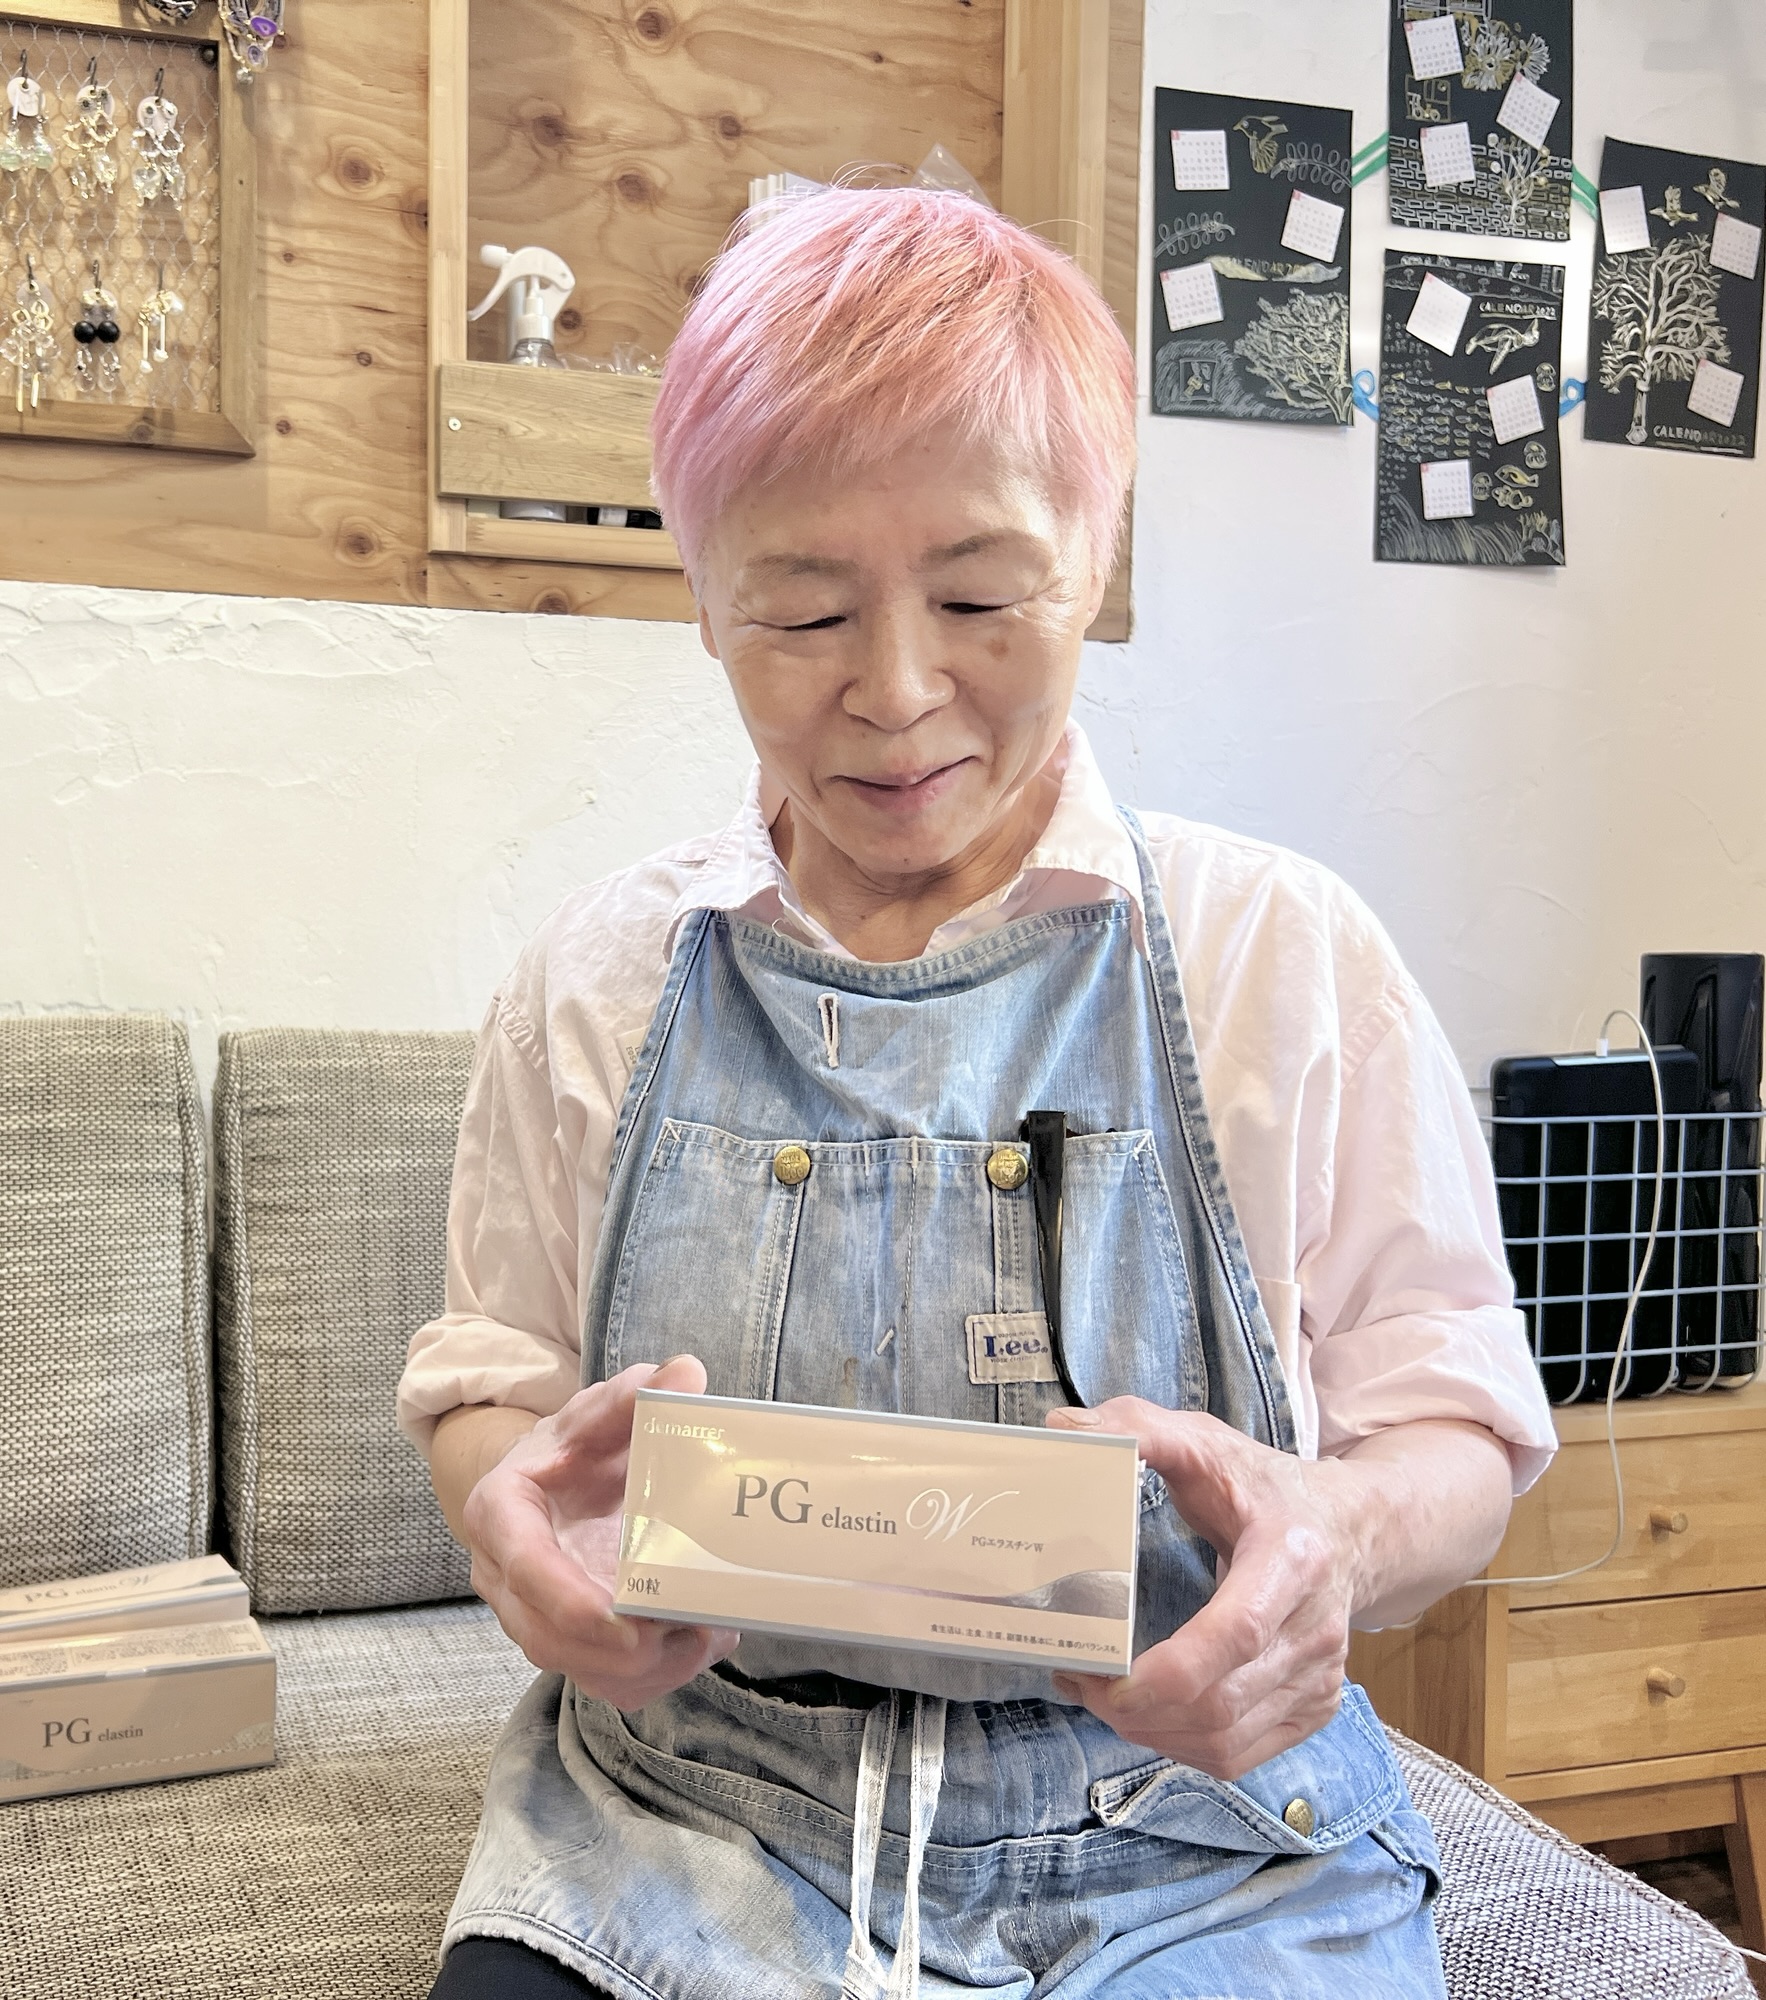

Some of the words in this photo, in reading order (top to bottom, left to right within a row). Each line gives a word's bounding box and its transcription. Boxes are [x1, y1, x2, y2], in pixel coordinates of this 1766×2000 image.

[731, 1473, 813, 1524] PG
[821, 1506, 897, 1535] elastin
[905, 1488, 1020, 1543] W
[970, 1535, 1045, 1553] PGエラスチンW
[627, 1576, 661, 1596] 90粒
[42, 1717, 92, 1749] PG
[97, 1726, 144, 1743] elastin
